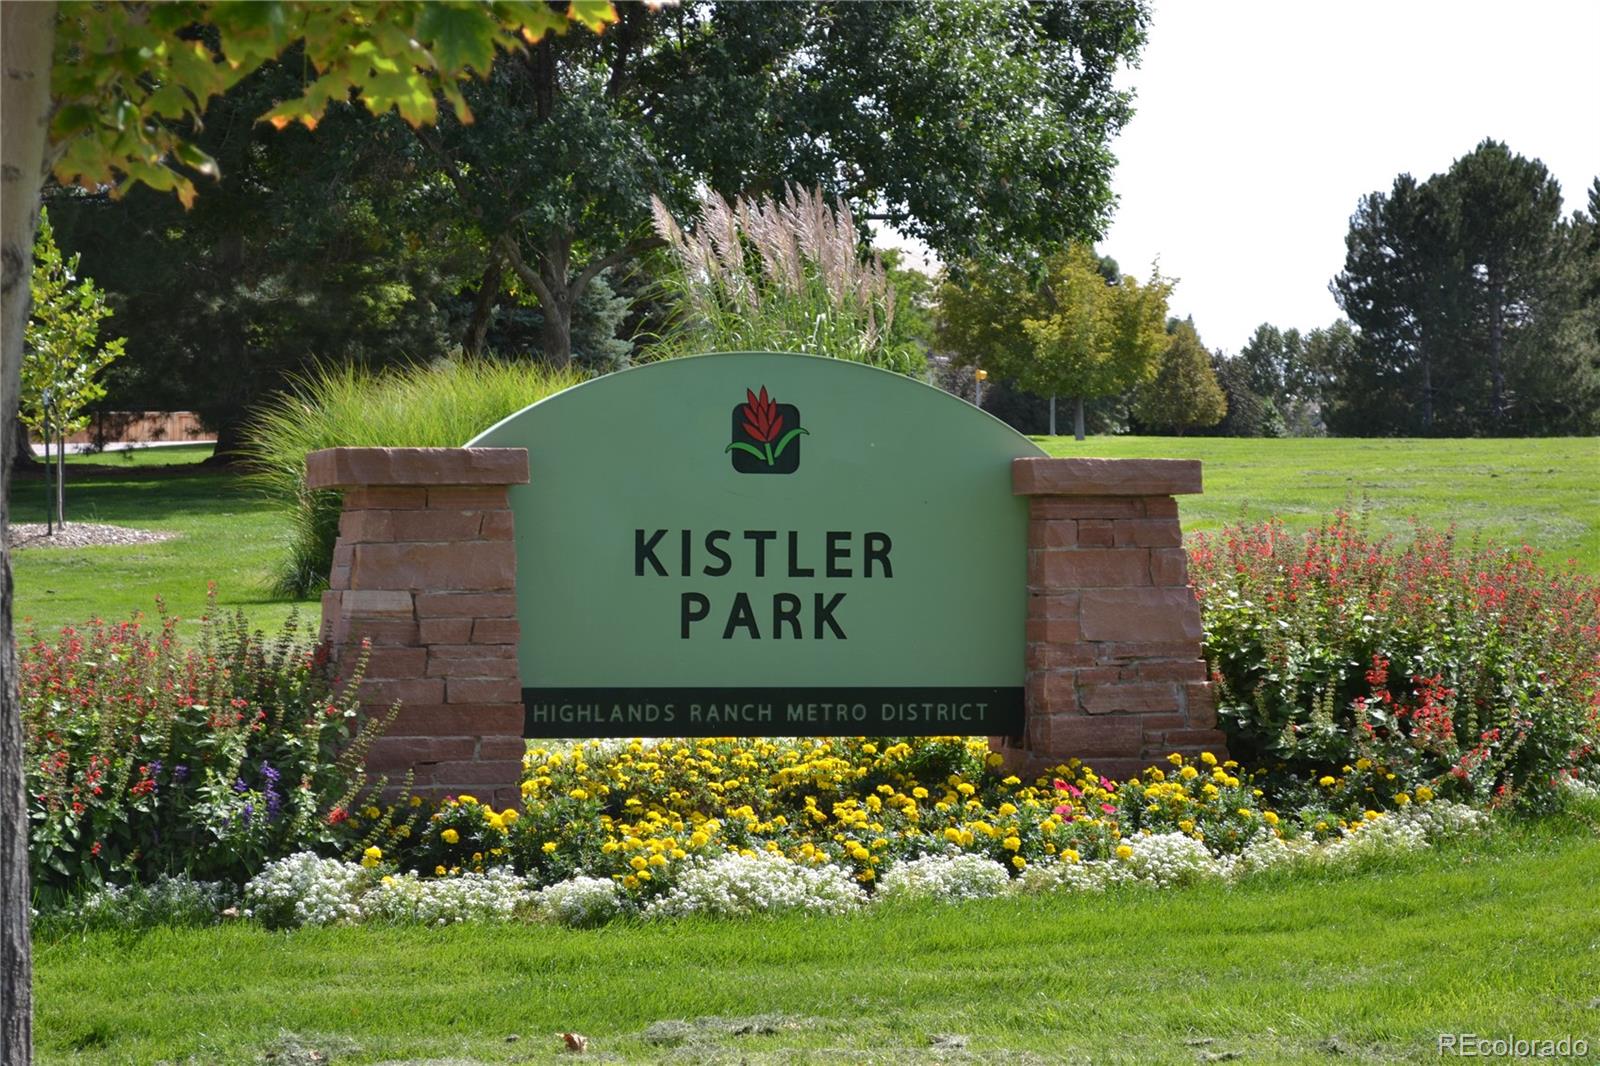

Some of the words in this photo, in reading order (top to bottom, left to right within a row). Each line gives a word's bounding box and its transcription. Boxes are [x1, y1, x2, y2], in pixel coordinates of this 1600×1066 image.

[634, 528, 894, 579] KISTLER
[680, 591, 848, 640] PARK
[533, 704, 676, 723] HIGHLANDS
[689, 703, 773, 722] RANCH
[786, 703, 867, 721] METRO
[881, 702, 989, 721] DISTRICT
